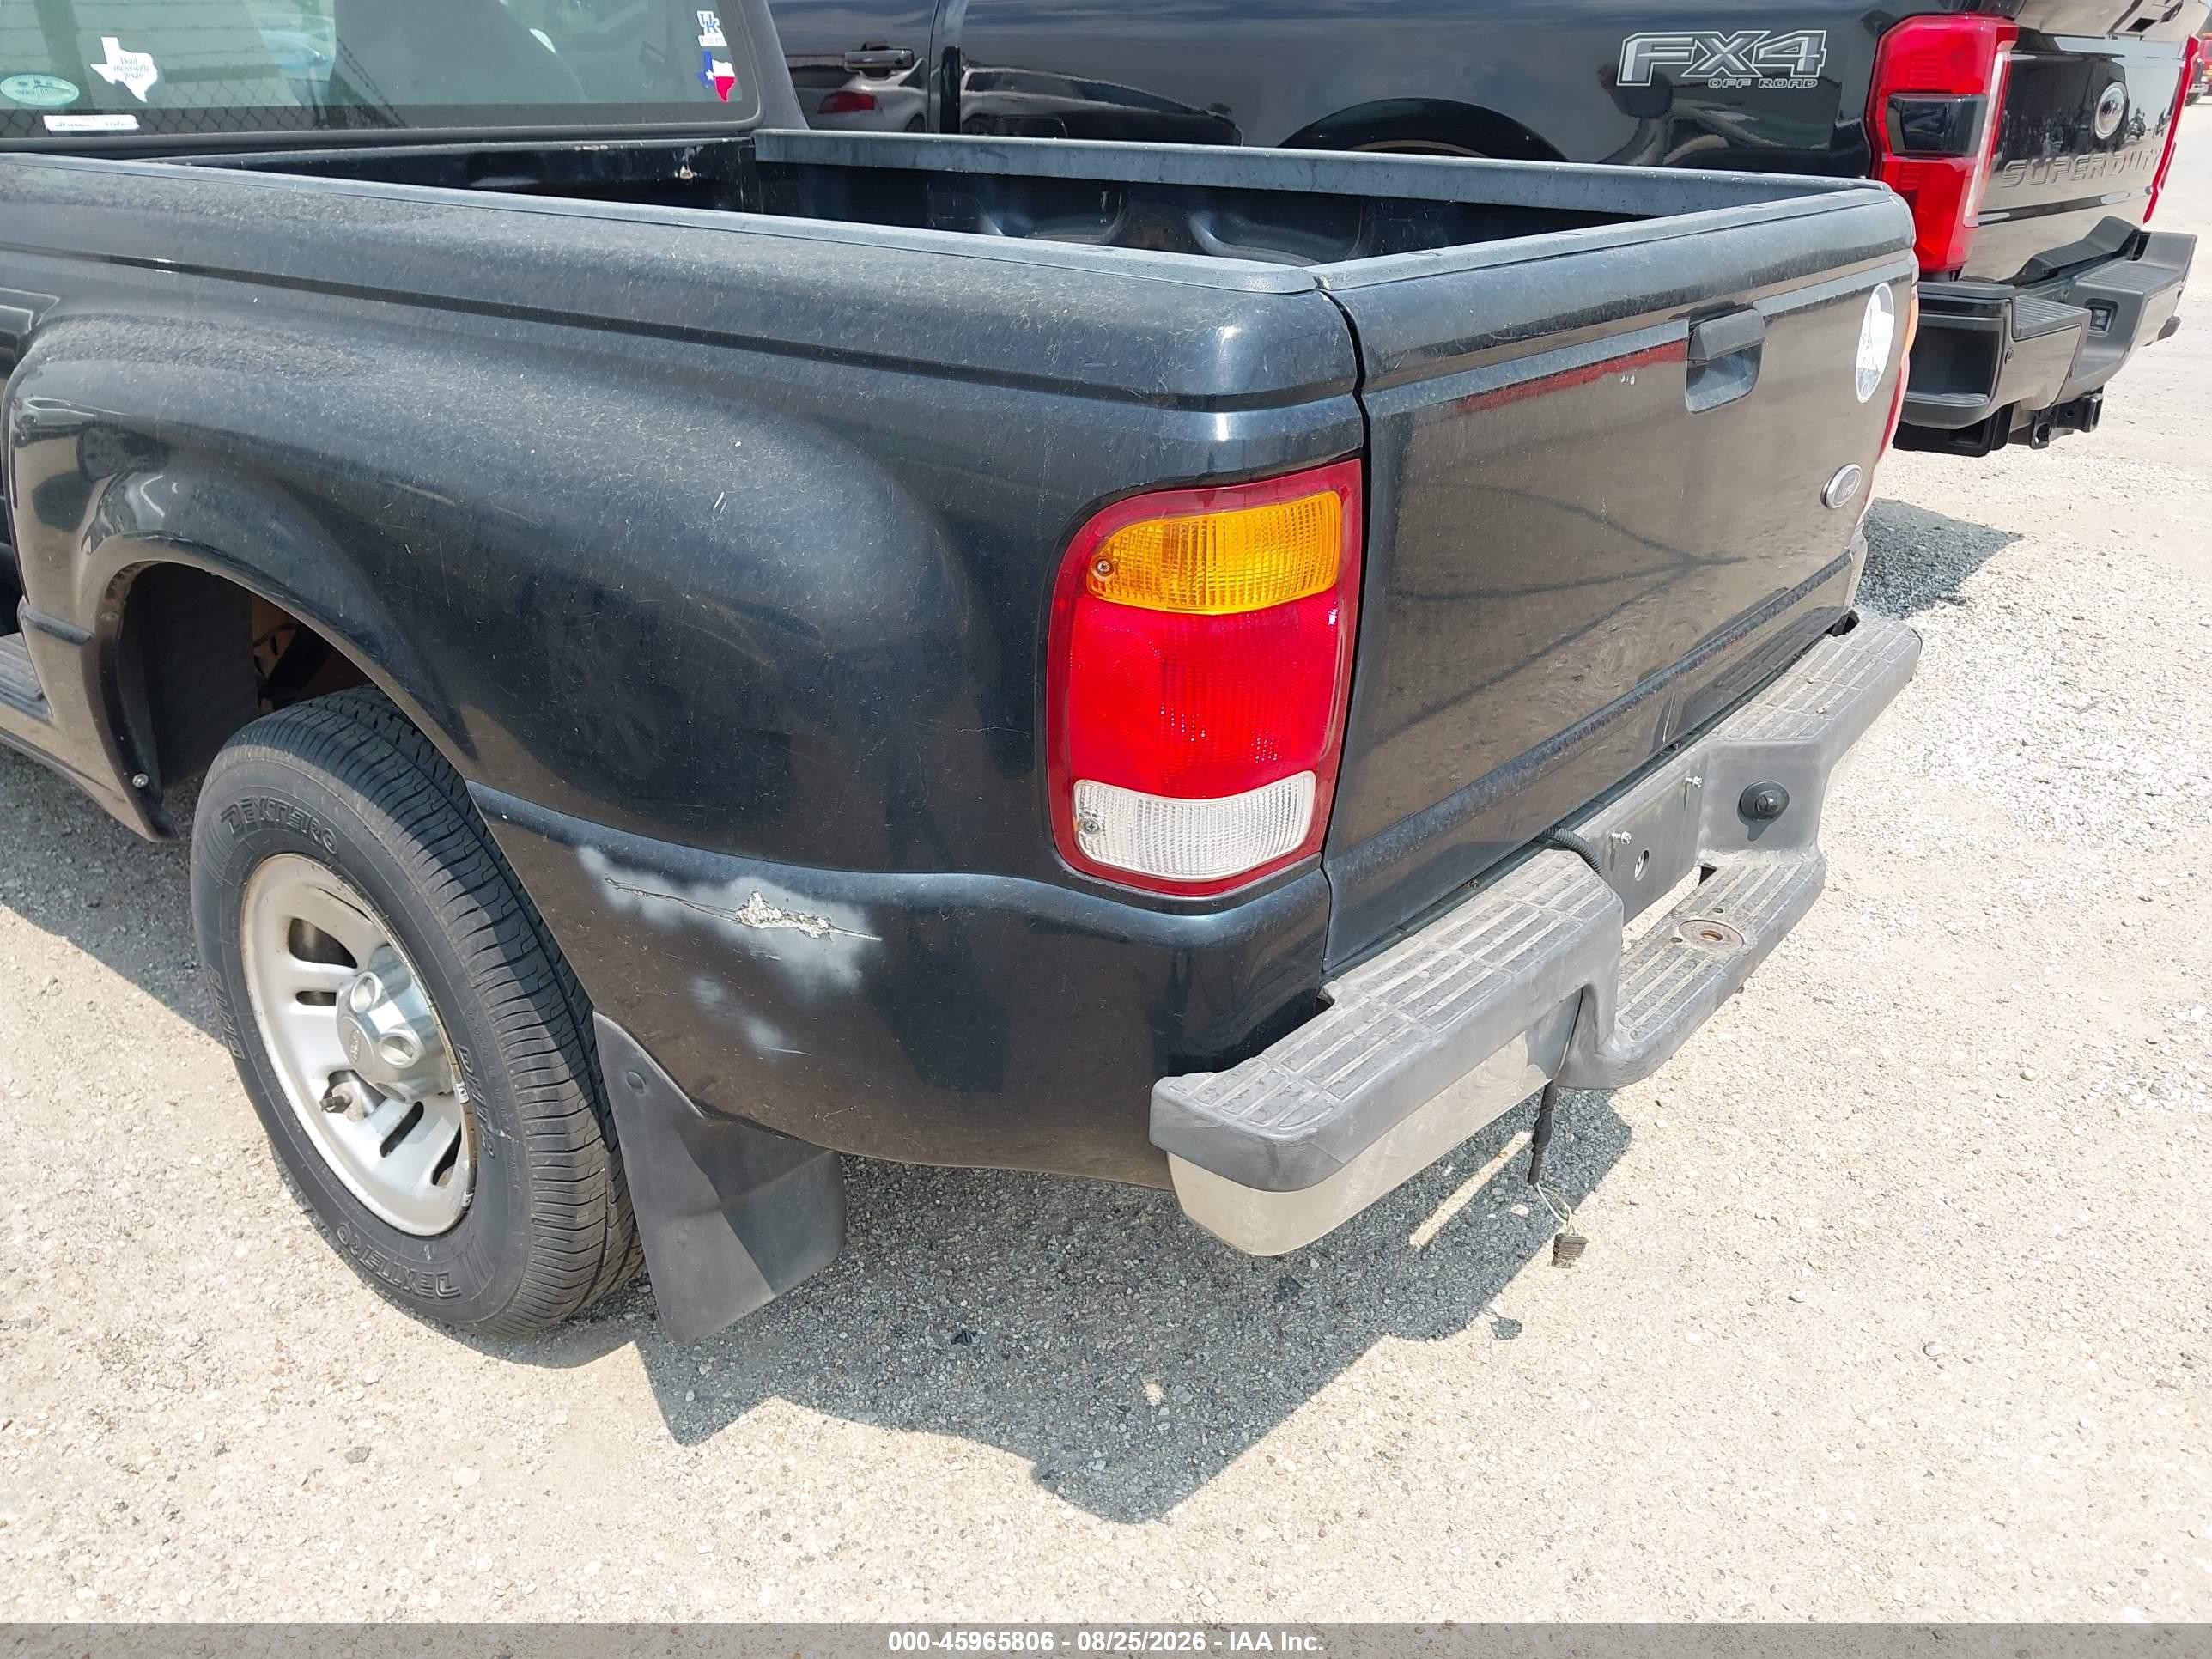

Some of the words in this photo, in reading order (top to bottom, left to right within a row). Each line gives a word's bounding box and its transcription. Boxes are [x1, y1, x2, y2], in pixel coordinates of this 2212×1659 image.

[699, 12, 720, 33] UK
[1616, 29, 1827, 87] FX4
[1707, 77, 1753, 89] OFF
[1757, 77, 1819, 89] ROAD
[2001, 152, 2107, 189] SUPER
[220, 795, 337, 855] DEXTERO
[337, 1222, 461, 1300] DEXTERO
